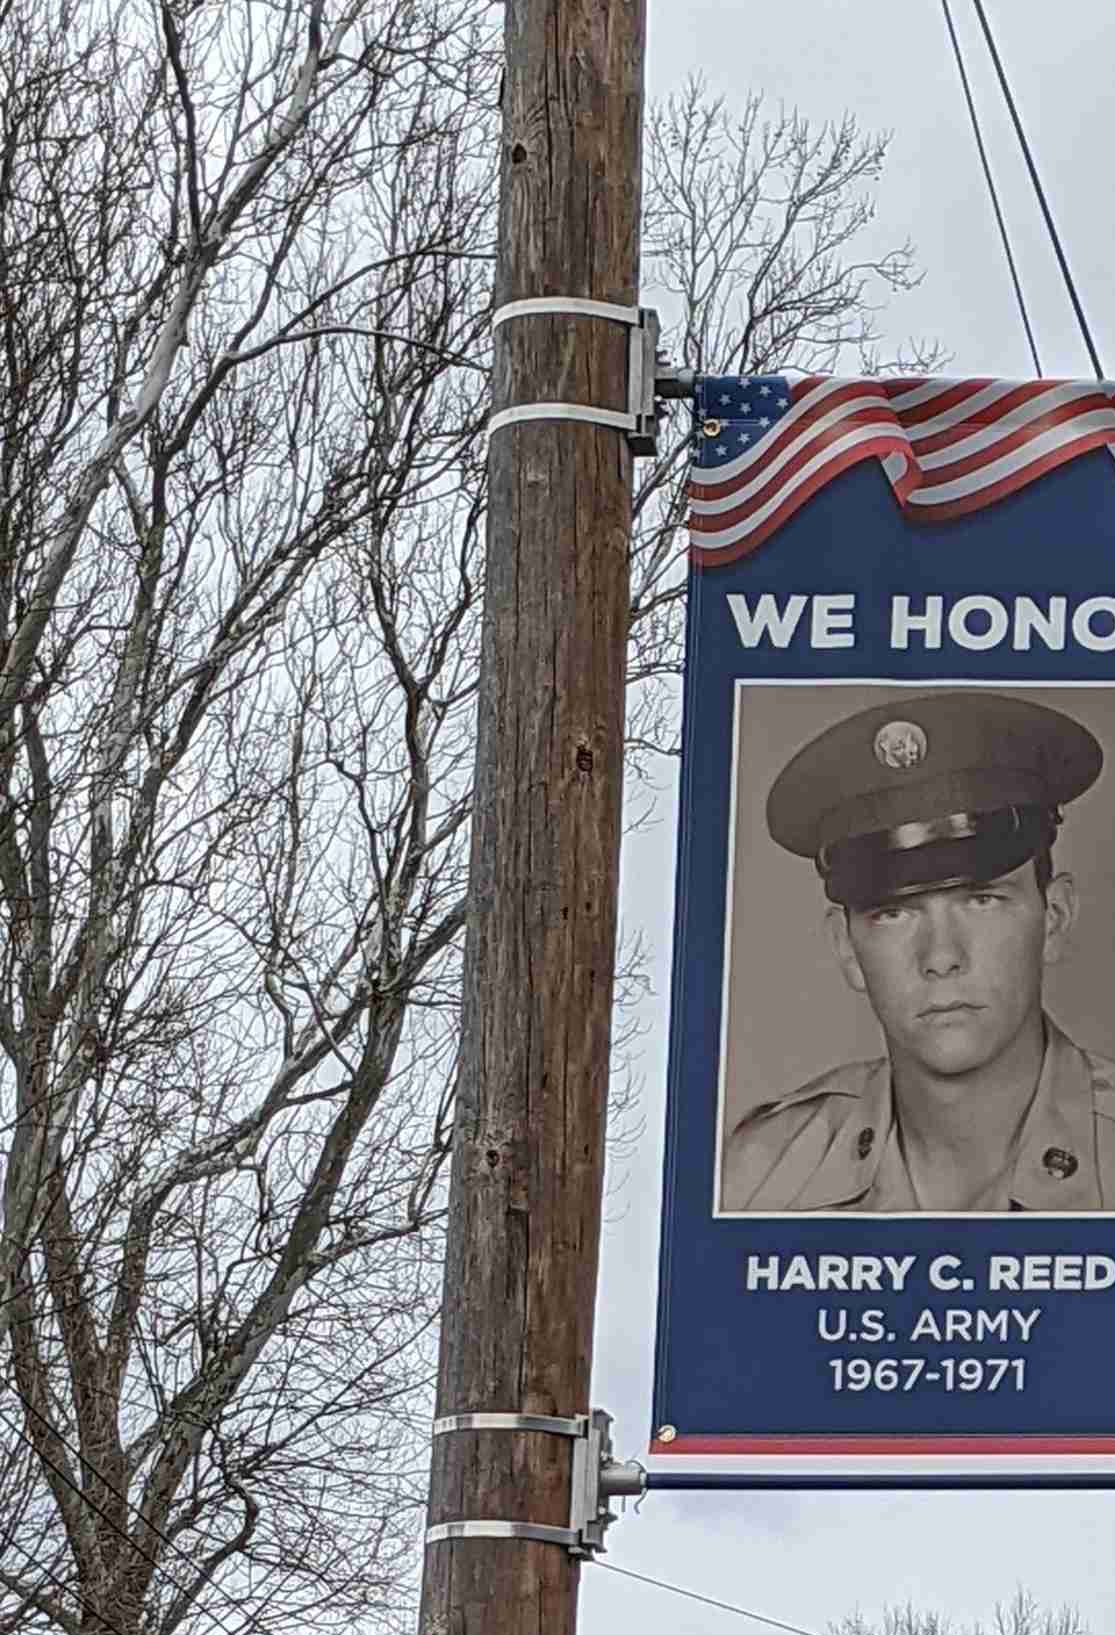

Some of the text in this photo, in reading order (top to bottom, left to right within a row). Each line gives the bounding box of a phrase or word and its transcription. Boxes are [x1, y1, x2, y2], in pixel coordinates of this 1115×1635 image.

[726, 593, 855, 648] WE
[746, 1255, 917, 1291] HARRY
[928, 1255, 975, 1291] C.
[817, 1308, 1041, 1342] U.S. ARMY
[828, 1358, 1026, 1392] 1967-1971
